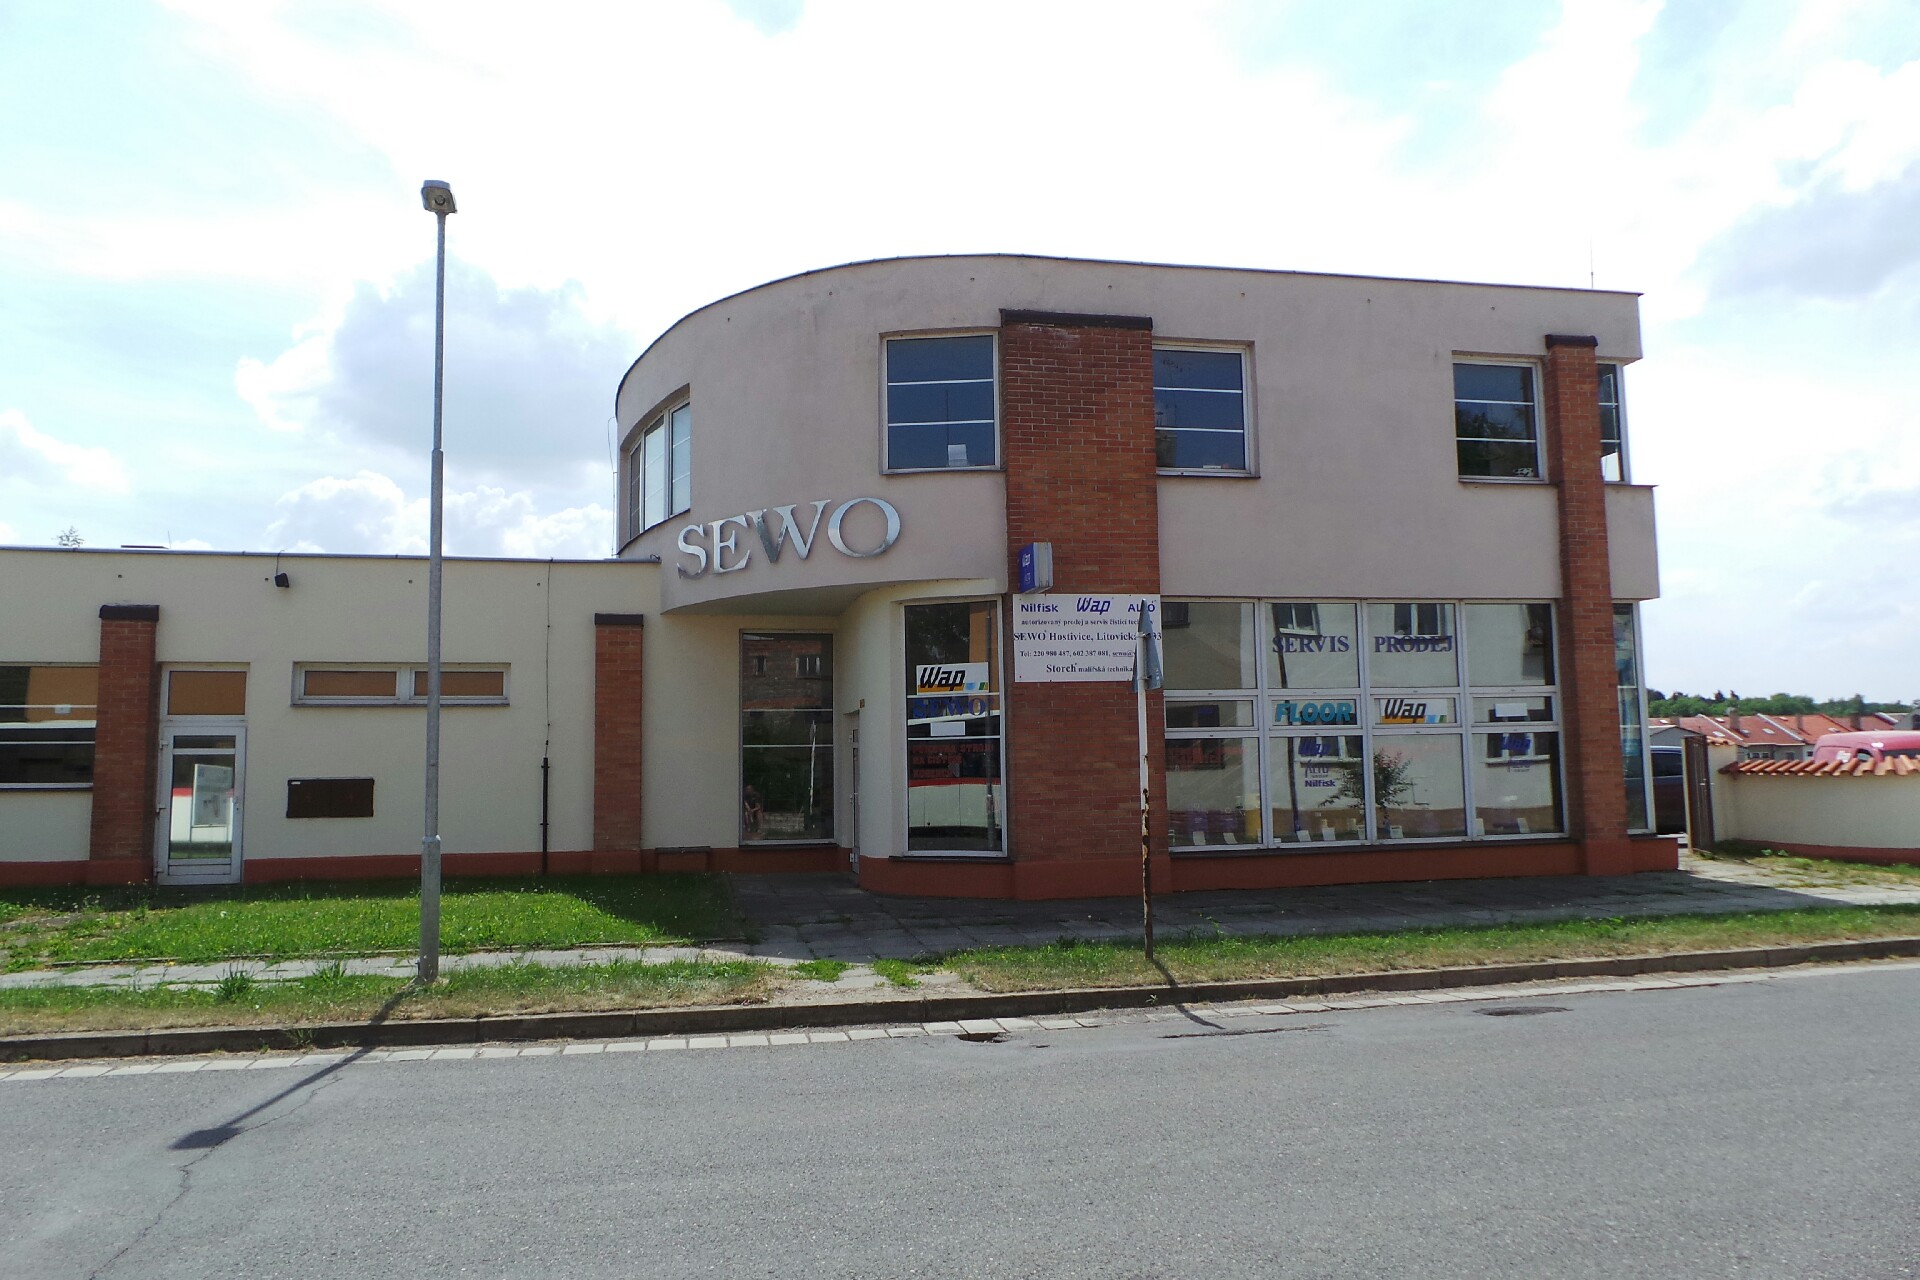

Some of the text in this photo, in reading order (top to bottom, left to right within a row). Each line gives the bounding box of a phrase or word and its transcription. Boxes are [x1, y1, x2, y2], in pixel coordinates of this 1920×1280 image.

[676, 497, 901, 579] SEWO
[1021, 603, 1059, 613] Nilfisk
[1076, 597, 1111, 615] Wap
[1127, 603, 1156, 613] ALO
[1063, 619, 1084, 627] prodej
[1013, 632, 1046, 641] SEWO
[1049, 631, 1094, 642] Hostivice,
[1272, 635, 1350, 653] SERVIS
[1374, 635, 1453, 653] PRODEJ
[1046, 664, 1077, 673] Storch
[920, 666, 966, 691] Wap
[1275, 703, 1353, 723] FLOOR
[1384, 699, 1427, 724] Wap
[1304, 779, 1336, 787] Nilfisk
